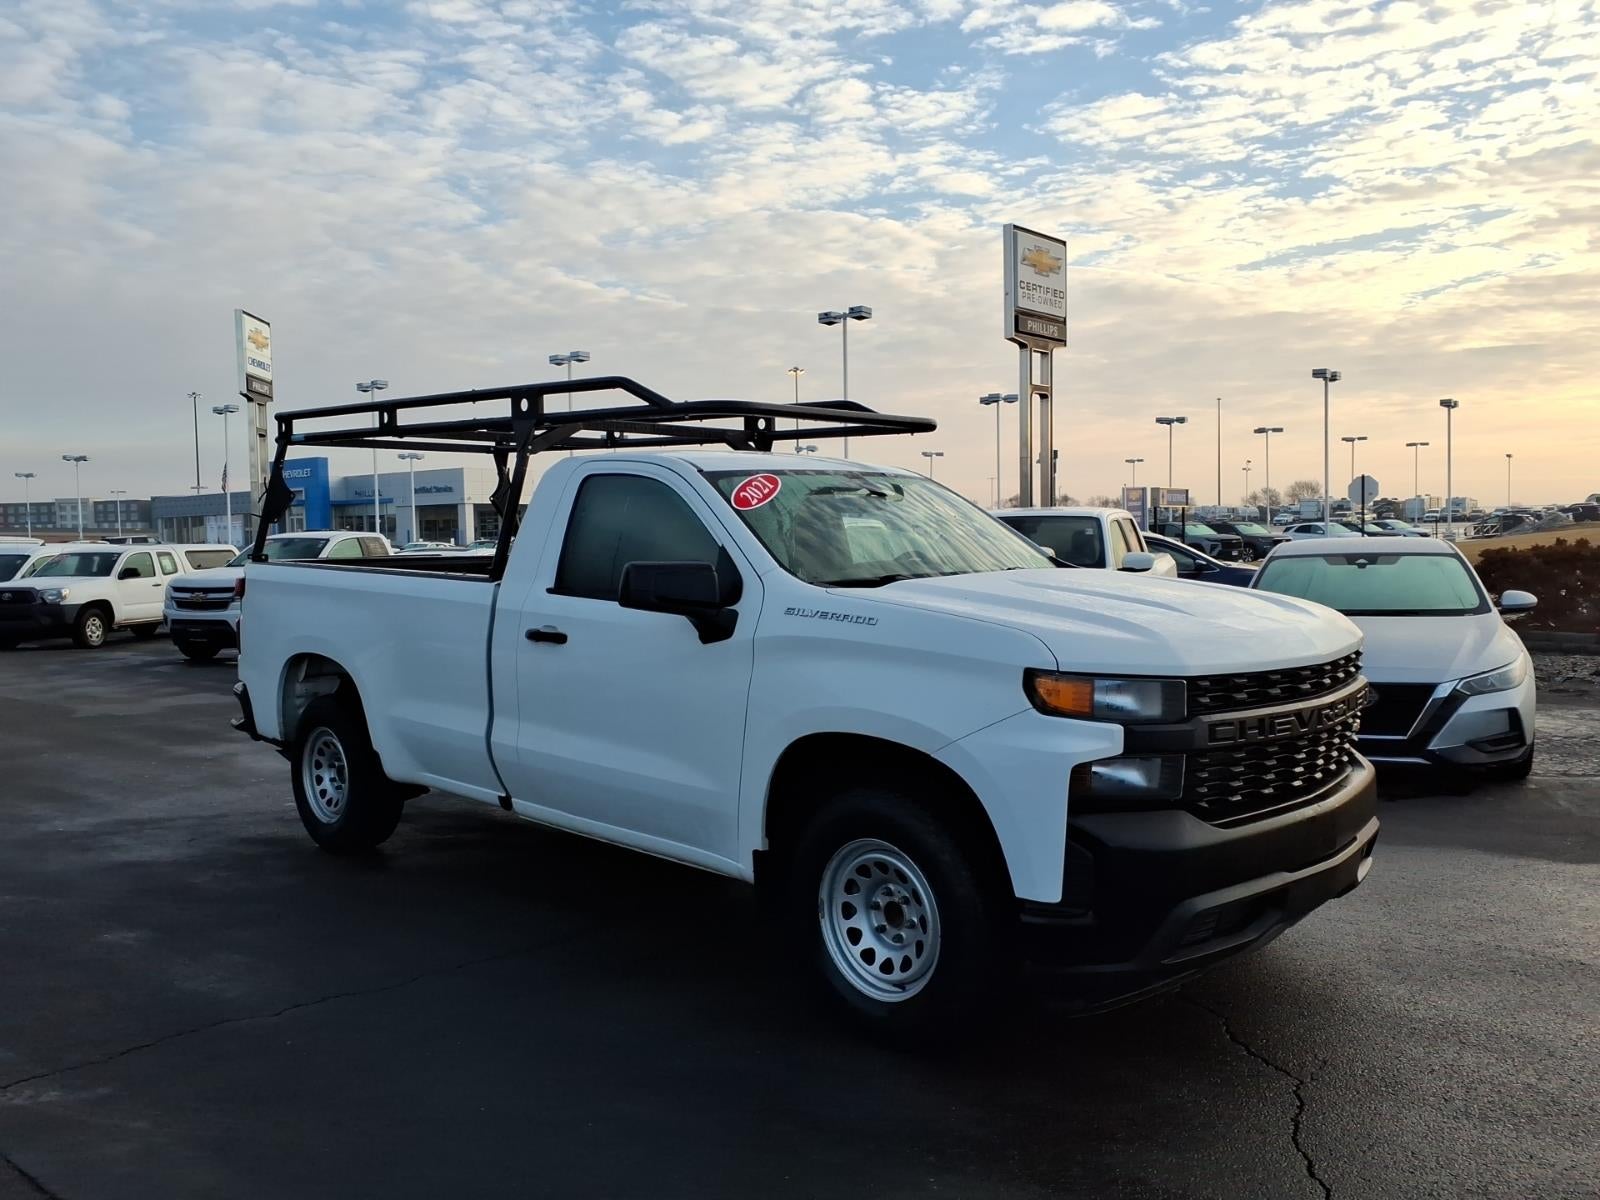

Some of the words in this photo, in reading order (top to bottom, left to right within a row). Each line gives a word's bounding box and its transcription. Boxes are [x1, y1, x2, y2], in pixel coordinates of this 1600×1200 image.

[1019, 280, 1065, 299] CERTIFIED
[1022, 292, 1063, 309] PRE-OWNED
[1027, 320, 1058, 337] PHILLIPS
[248, 356, 271, 372] CHEVROLET
[282, 469, 311, 479] HEVROLET
[739, 476, 774, 505] 2021
[783, 607, 879, 626] SILVERADO
[1207, 687, 1369, 745] CHEVROLET
